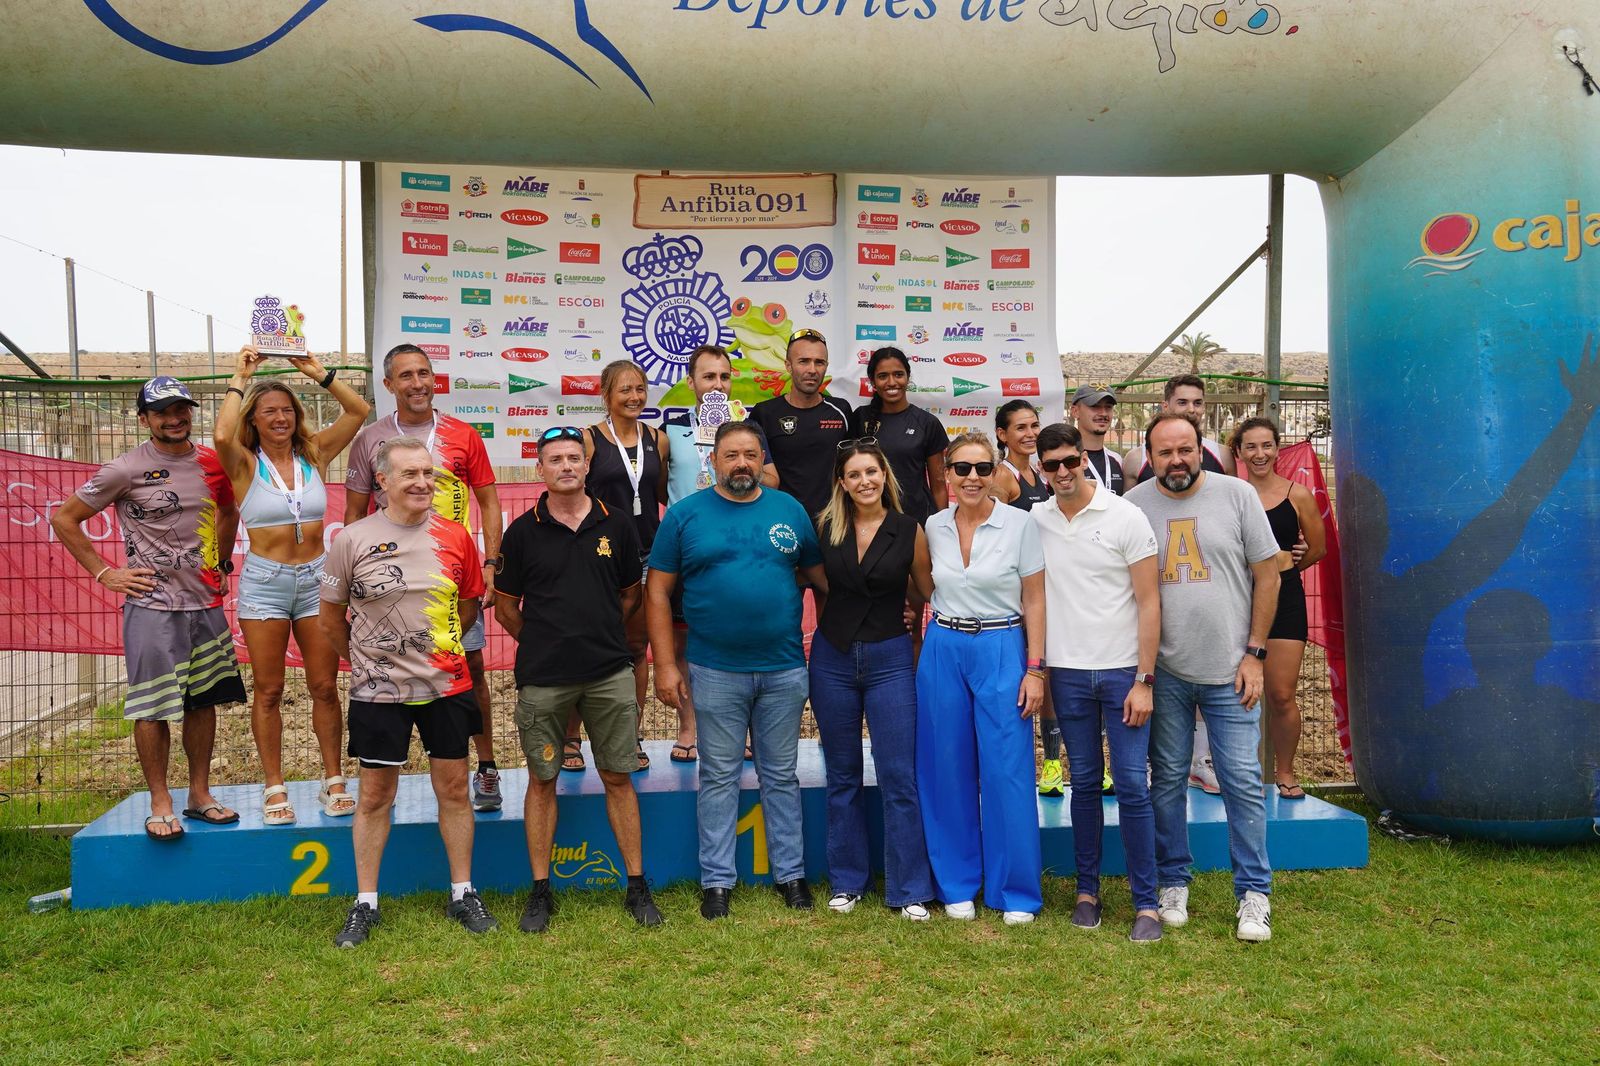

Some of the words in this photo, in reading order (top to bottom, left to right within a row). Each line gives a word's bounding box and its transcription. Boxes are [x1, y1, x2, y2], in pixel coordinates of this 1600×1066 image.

[503, 179, 550, 193] MABE
[709, 182, 757, 196] Ruta
[420, 203, 446, 212] sotrafa
[660, 196, 752, 213] Anfibia
[755, 192, 808, 213] 091
[709, 215, 733, 223] tierra
[734, 216, 741, 225] y
[742, 216, 757, 225] por
[419, 243, 441, 251] Unión
[403, 272, 448, 283] Murgiverde
[505, 272, 546, 285] Blanes
[858, 282, 895, 292] Murgiverde
[943, 280, 980, 291] Blanes
[657, 297, 691, 311] POLICÍA
[503, 320, 550, 333] MABE
[666, 353, 691, 362] NACI
[507, 406, 548, 417] Blanes
[949, 407, 988, 417] Blanes
[452, 480, 462, 521] NFIBIA
[1159, 516, 1211, 585] A
[451, 563, 463, 585] 091
[735, 801, 771, 875] 1
[550, 840, 588, 864] imd
[290, 840, 330, 896] 2
